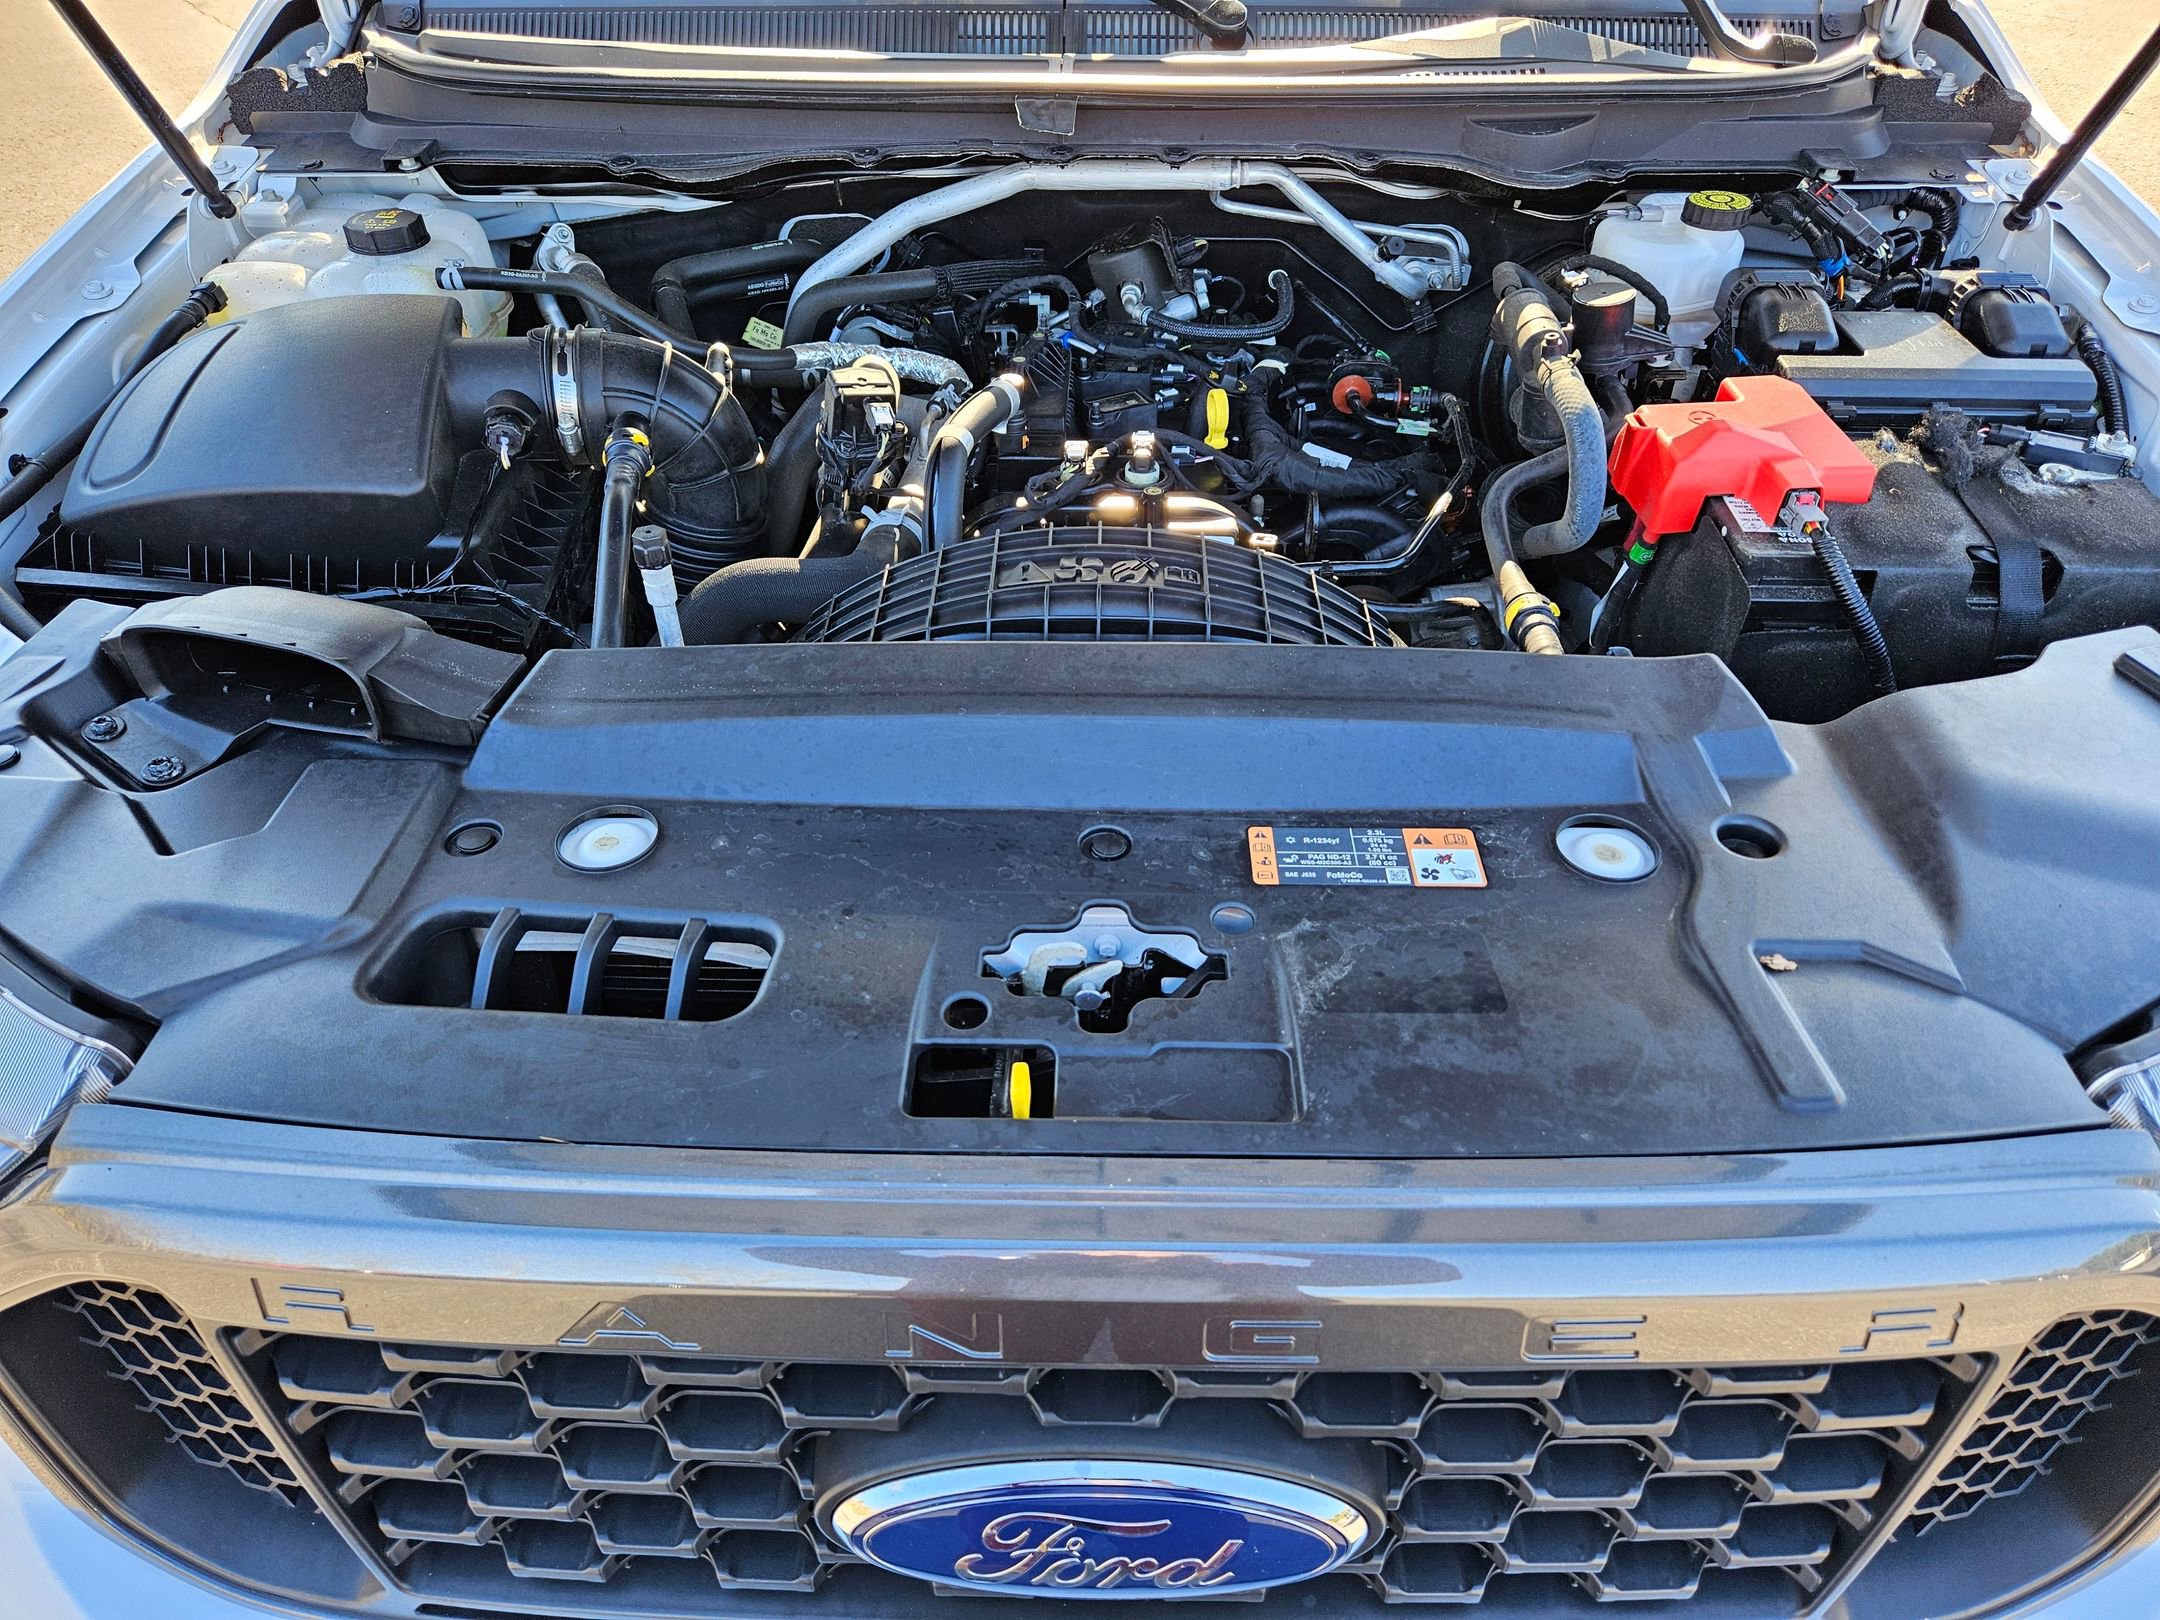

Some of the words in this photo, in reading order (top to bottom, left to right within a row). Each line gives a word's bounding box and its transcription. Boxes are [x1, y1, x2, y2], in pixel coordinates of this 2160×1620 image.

[1303, 837, 1340, 845] R-1234yf
[1383, 837, 1394, 845] kg
[1326, 871, 1363, 879] FoMoCo
[250, 1277, 1966, 1364] RANGER
[955, 1512, 1243, 1590] Ford
